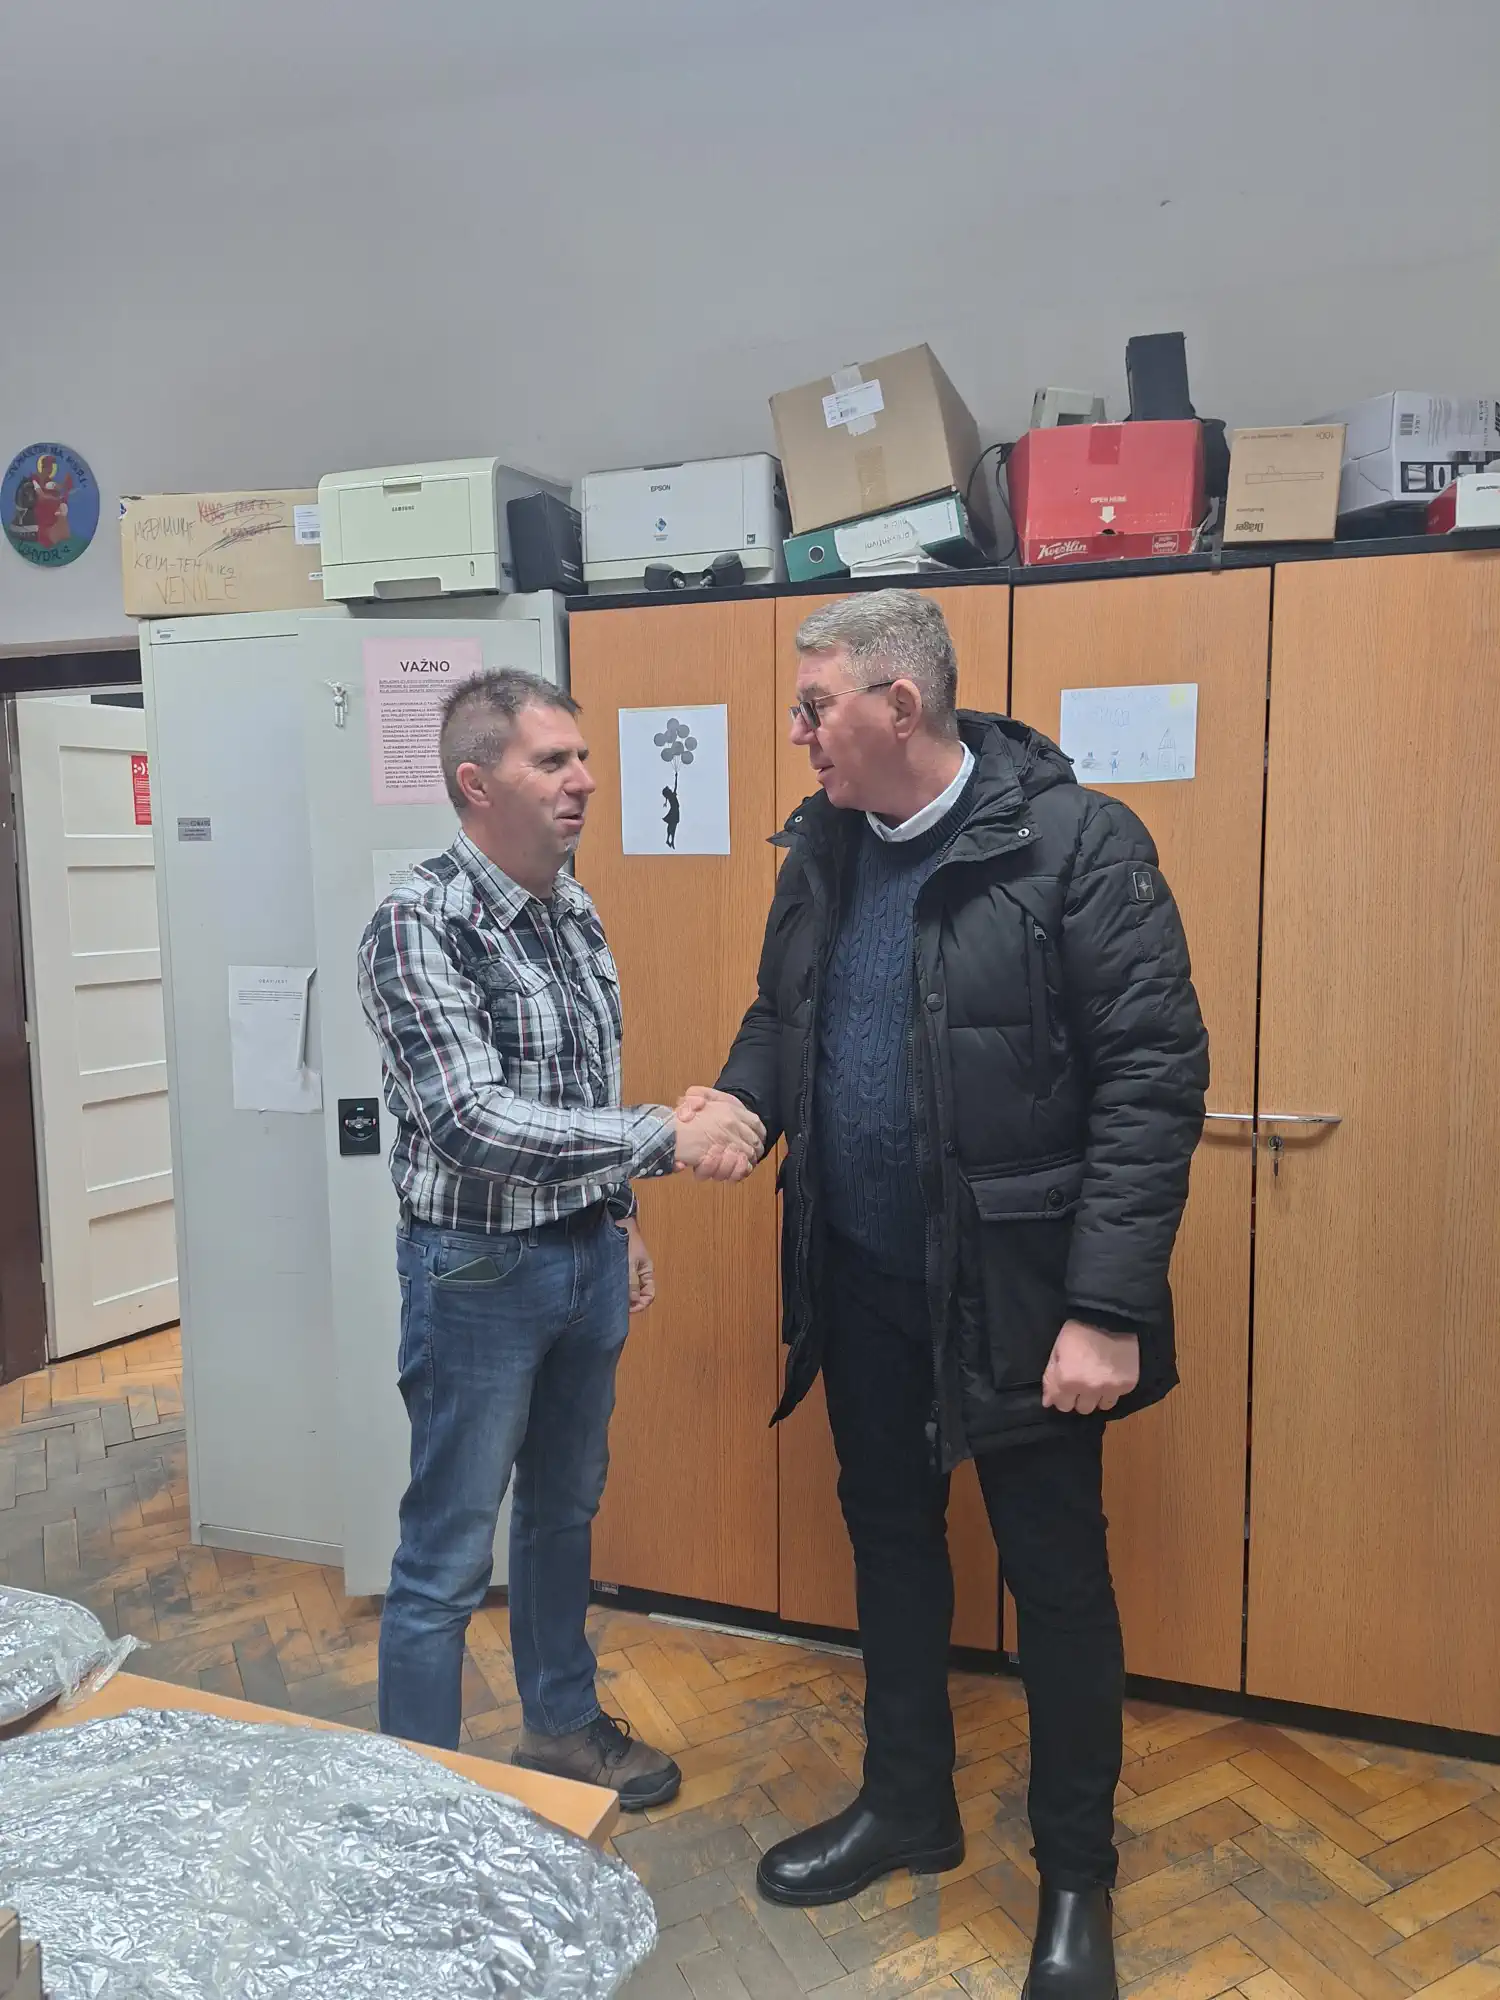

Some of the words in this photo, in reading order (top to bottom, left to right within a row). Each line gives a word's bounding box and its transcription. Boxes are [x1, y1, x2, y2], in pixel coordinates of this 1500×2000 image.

[650, 484, 671, 492] EPSON
[1234, 521, 1265, 533] Dräger
[399, 658, 450, 672] VAŽNO
